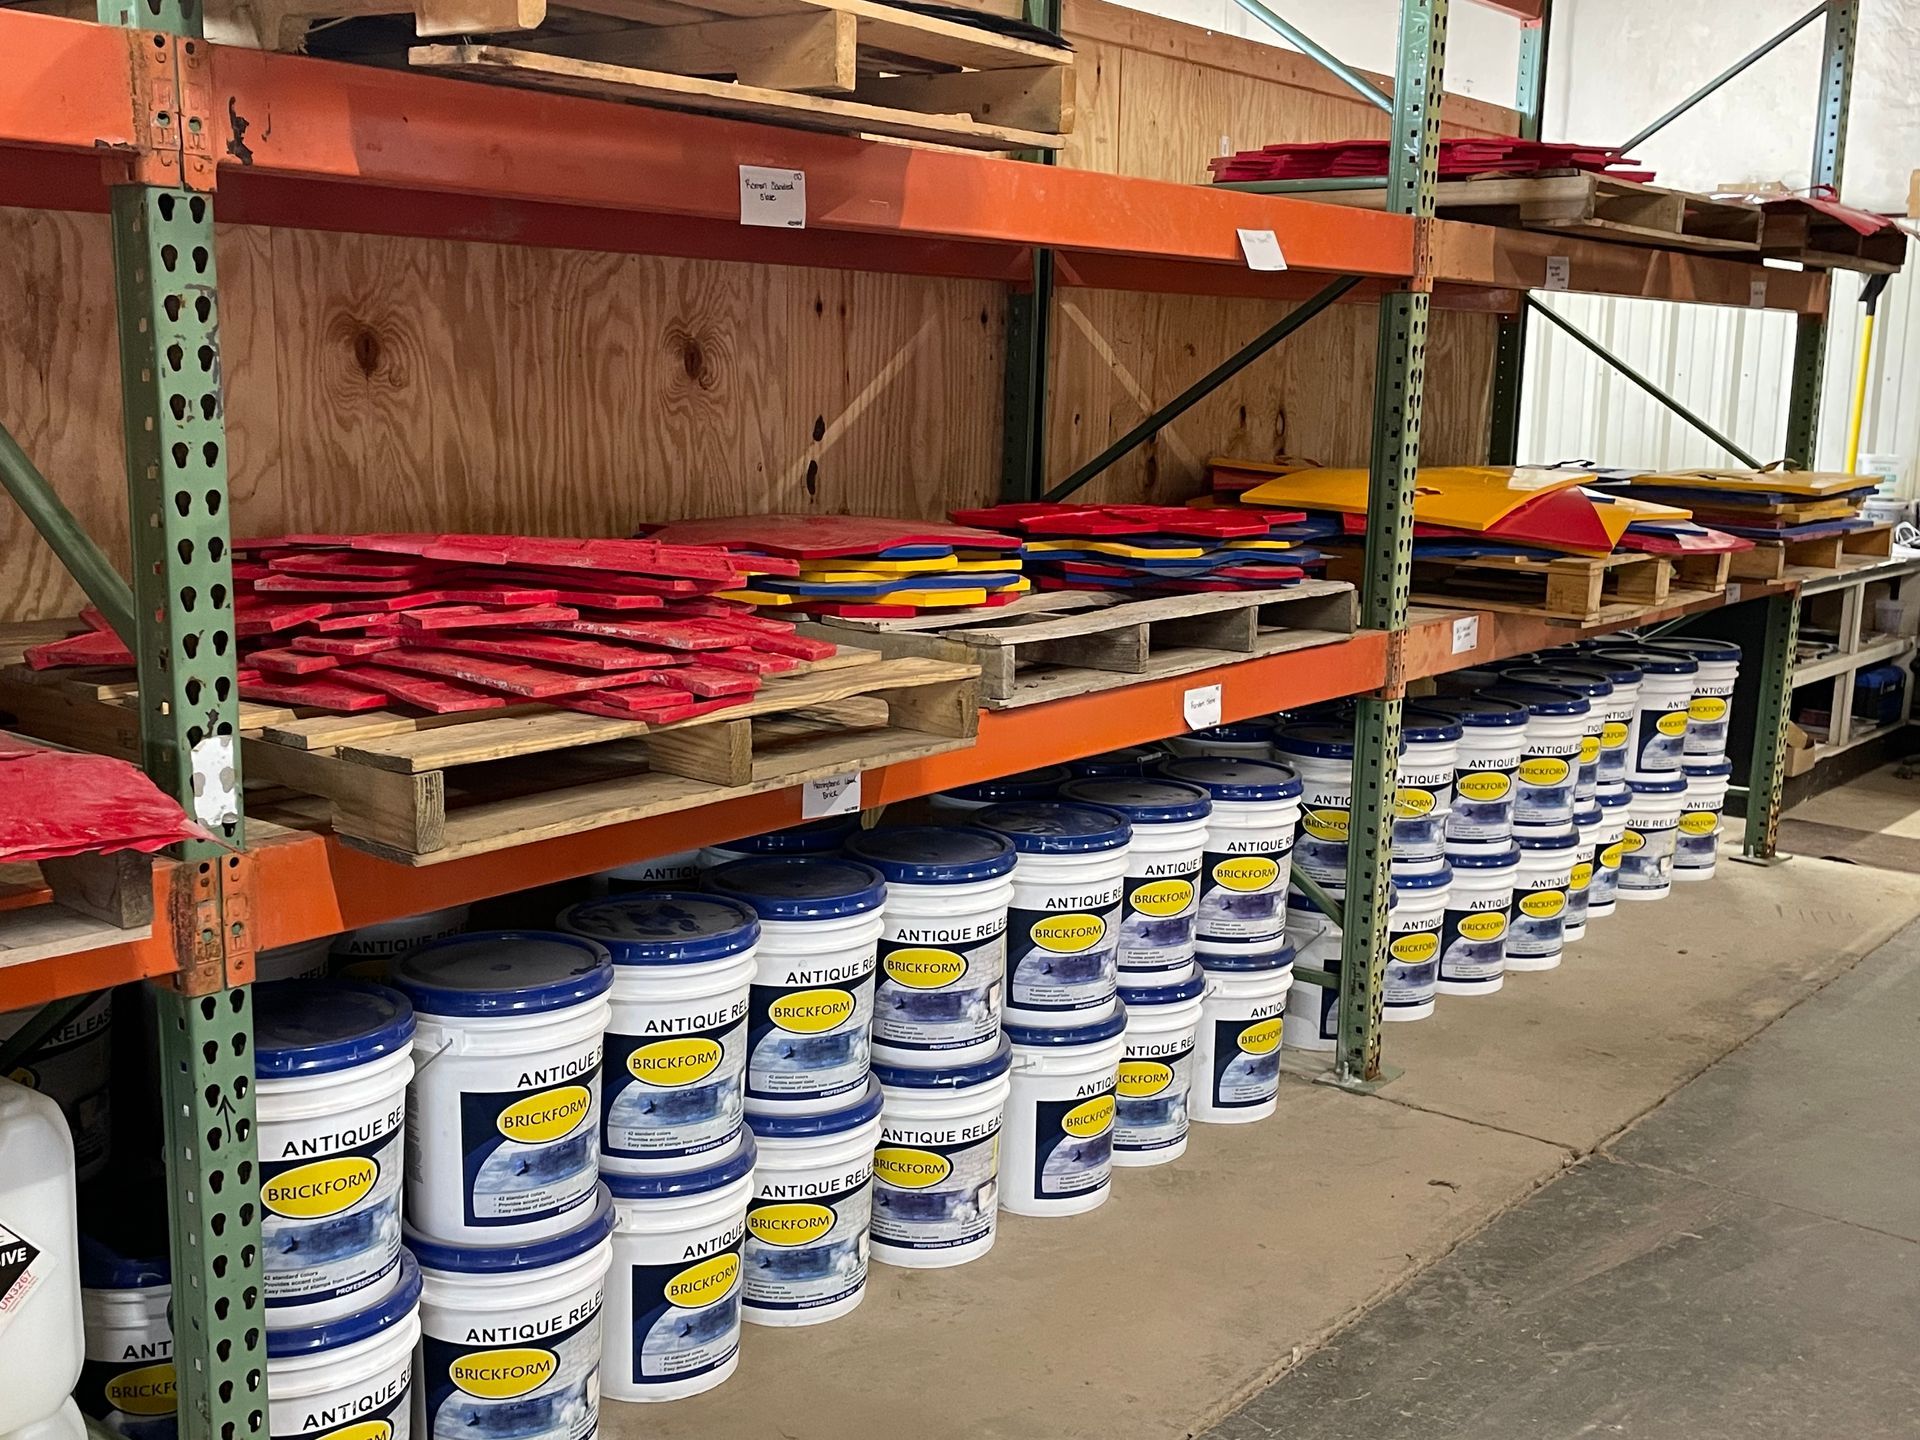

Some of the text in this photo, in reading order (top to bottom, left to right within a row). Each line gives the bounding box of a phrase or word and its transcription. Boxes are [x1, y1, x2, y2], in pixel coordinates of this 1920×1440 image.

[1605, 710, 1632, 719] NTIQUE
[1528, 745, 1573, 754] ANTIQUE
[1469, 756, 1514, 768] ANTIQUE
[1227, 839, 1283, 852] ANTIQUE
[643, 866, 704, 879] ANTIQU
[1145, 858, 1198, 875] ANTIQUE
[1217, 868, 1275, 878] BRICKFORM
[1045, 892, 1109, 908] ANTIQUE
[1135, 889, 1191, 903] BRICKFORM
[1403, 915, 1441, 930] ANTIQUE
[897, 928, 971, 942] ANTIQUE
[1035, 925, 1102, 938] BRICKFORM
[785, 963, 859, 984] ANTIQUE
[887, 960, 960, 973] BRICKFORM
[774, 1001, 850, 1018] BRICKFORM
[645, 1009, 727, 1033] ANTIQUE
[1126, 1042, 1178, 1056] NTIQUE
[633, 1050, 718, 1069] BRICKFORM
[517, 1051, 595, 1088] ANTIQUE
[1120, 1072, 1169, 1083] ICKFORM
[504, 1097, 587, 1129] BRICKFORM
[281, 1119, 383, 1158] ANTIQUE
[881, 1127, 956, 1144] ANTIQUE
[873, 1158, 945, 1174] BRICKFORM
[268, 1169, 372, 1201] BRICKFORM
[760, 1179, 840, 1198] ANTIQUE
[751, 1215, 830, 1230] BRICKFORM
[683, 1220, 743, 1259] ANTIQUE
[0, 1247, 27, 1267] IVE
[466, 1288, 602, 1342] ANTIQUE RELE
[455, 1360, 551, 1380] BRICKFORM
[303, 1380, 396, 1431] ANTIQUE
